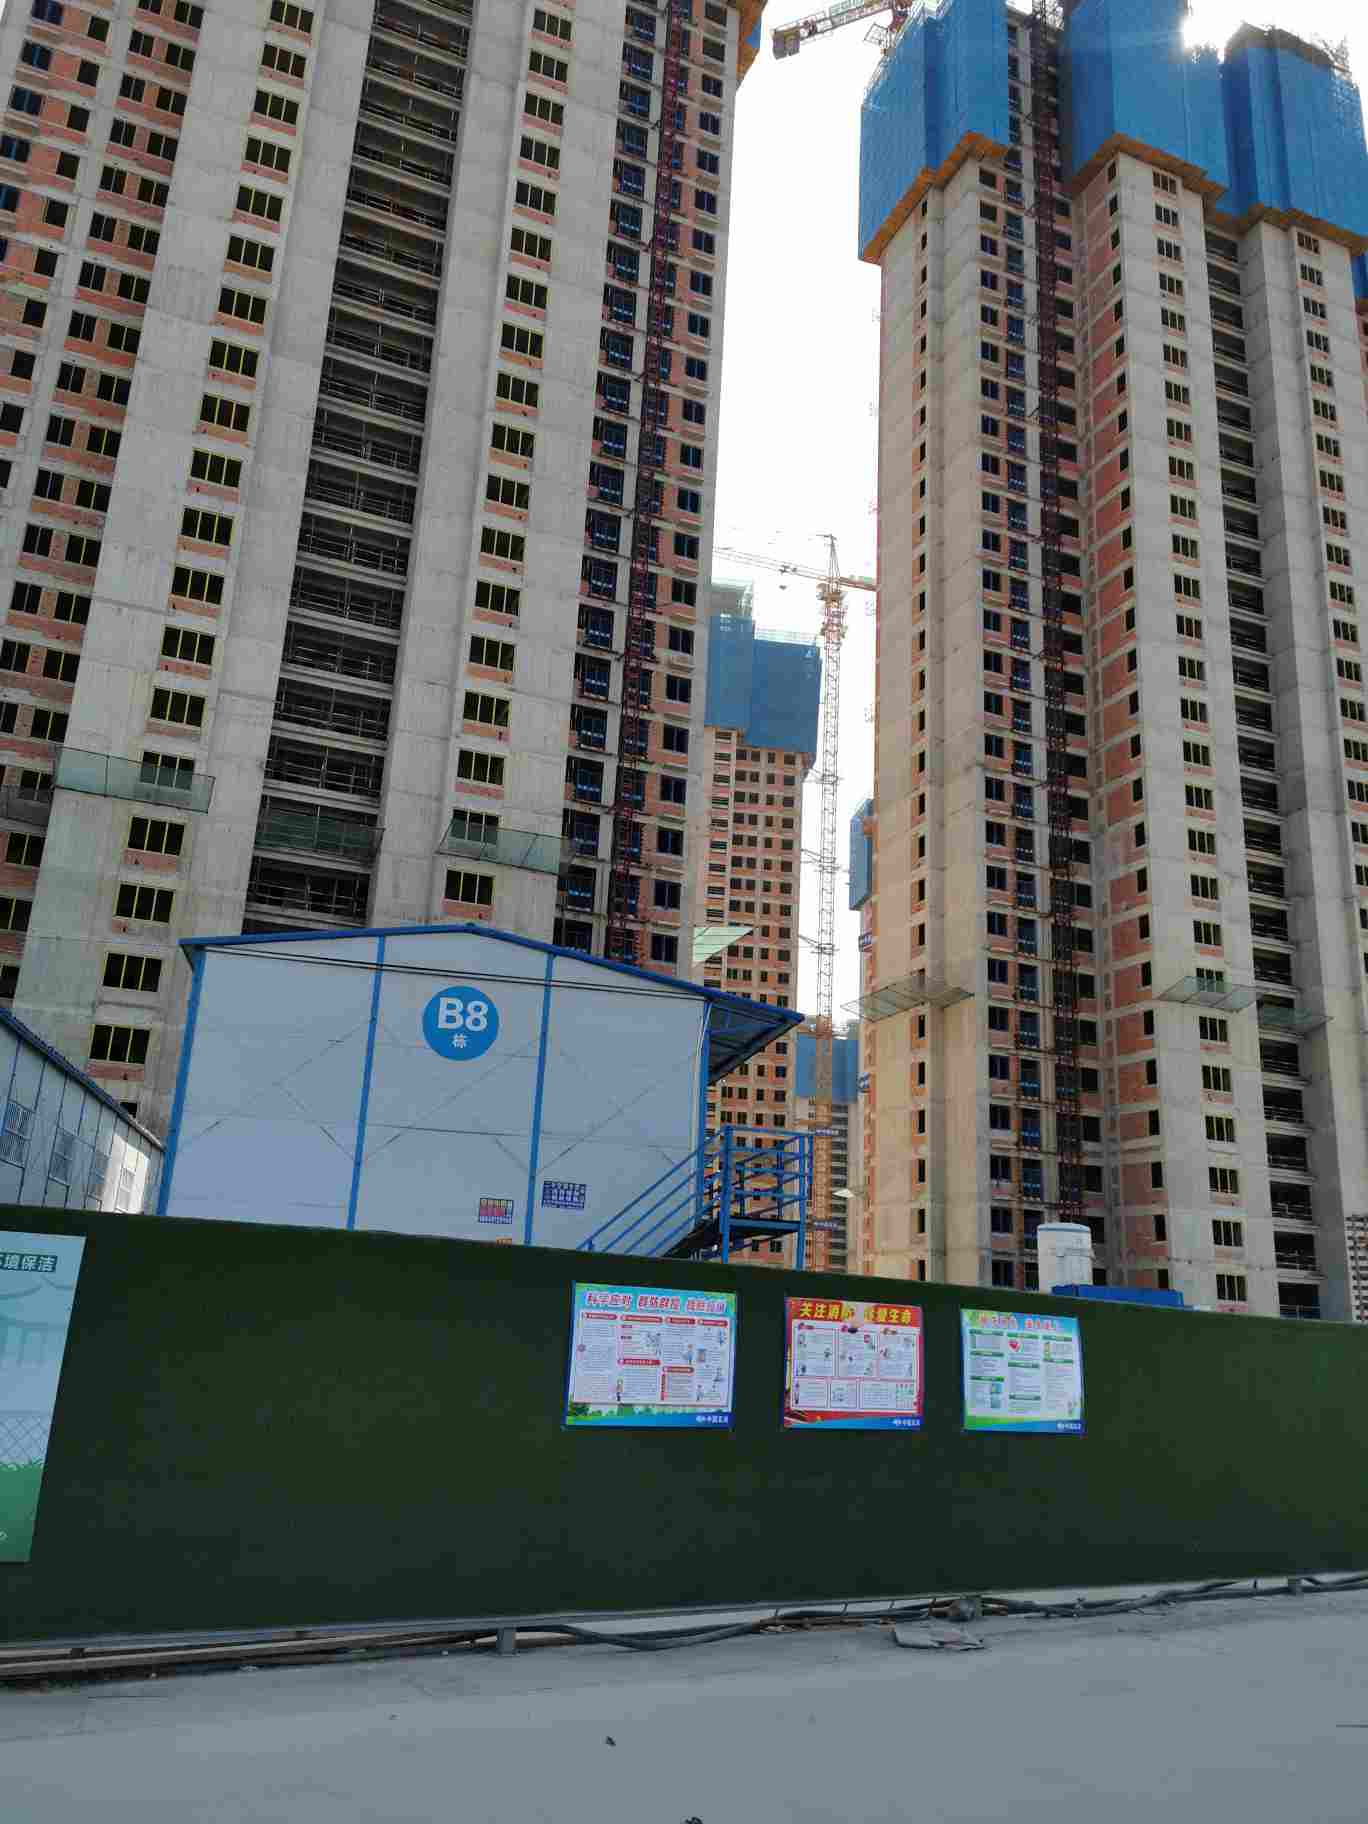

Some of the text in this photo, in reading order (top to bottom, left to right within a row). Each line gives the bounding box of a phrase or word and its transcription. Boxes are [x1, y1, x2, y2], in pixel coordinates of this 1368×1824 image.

[438, 997, 489, 1032] B8
[0, 1254, 56, 1272] 境保洁
